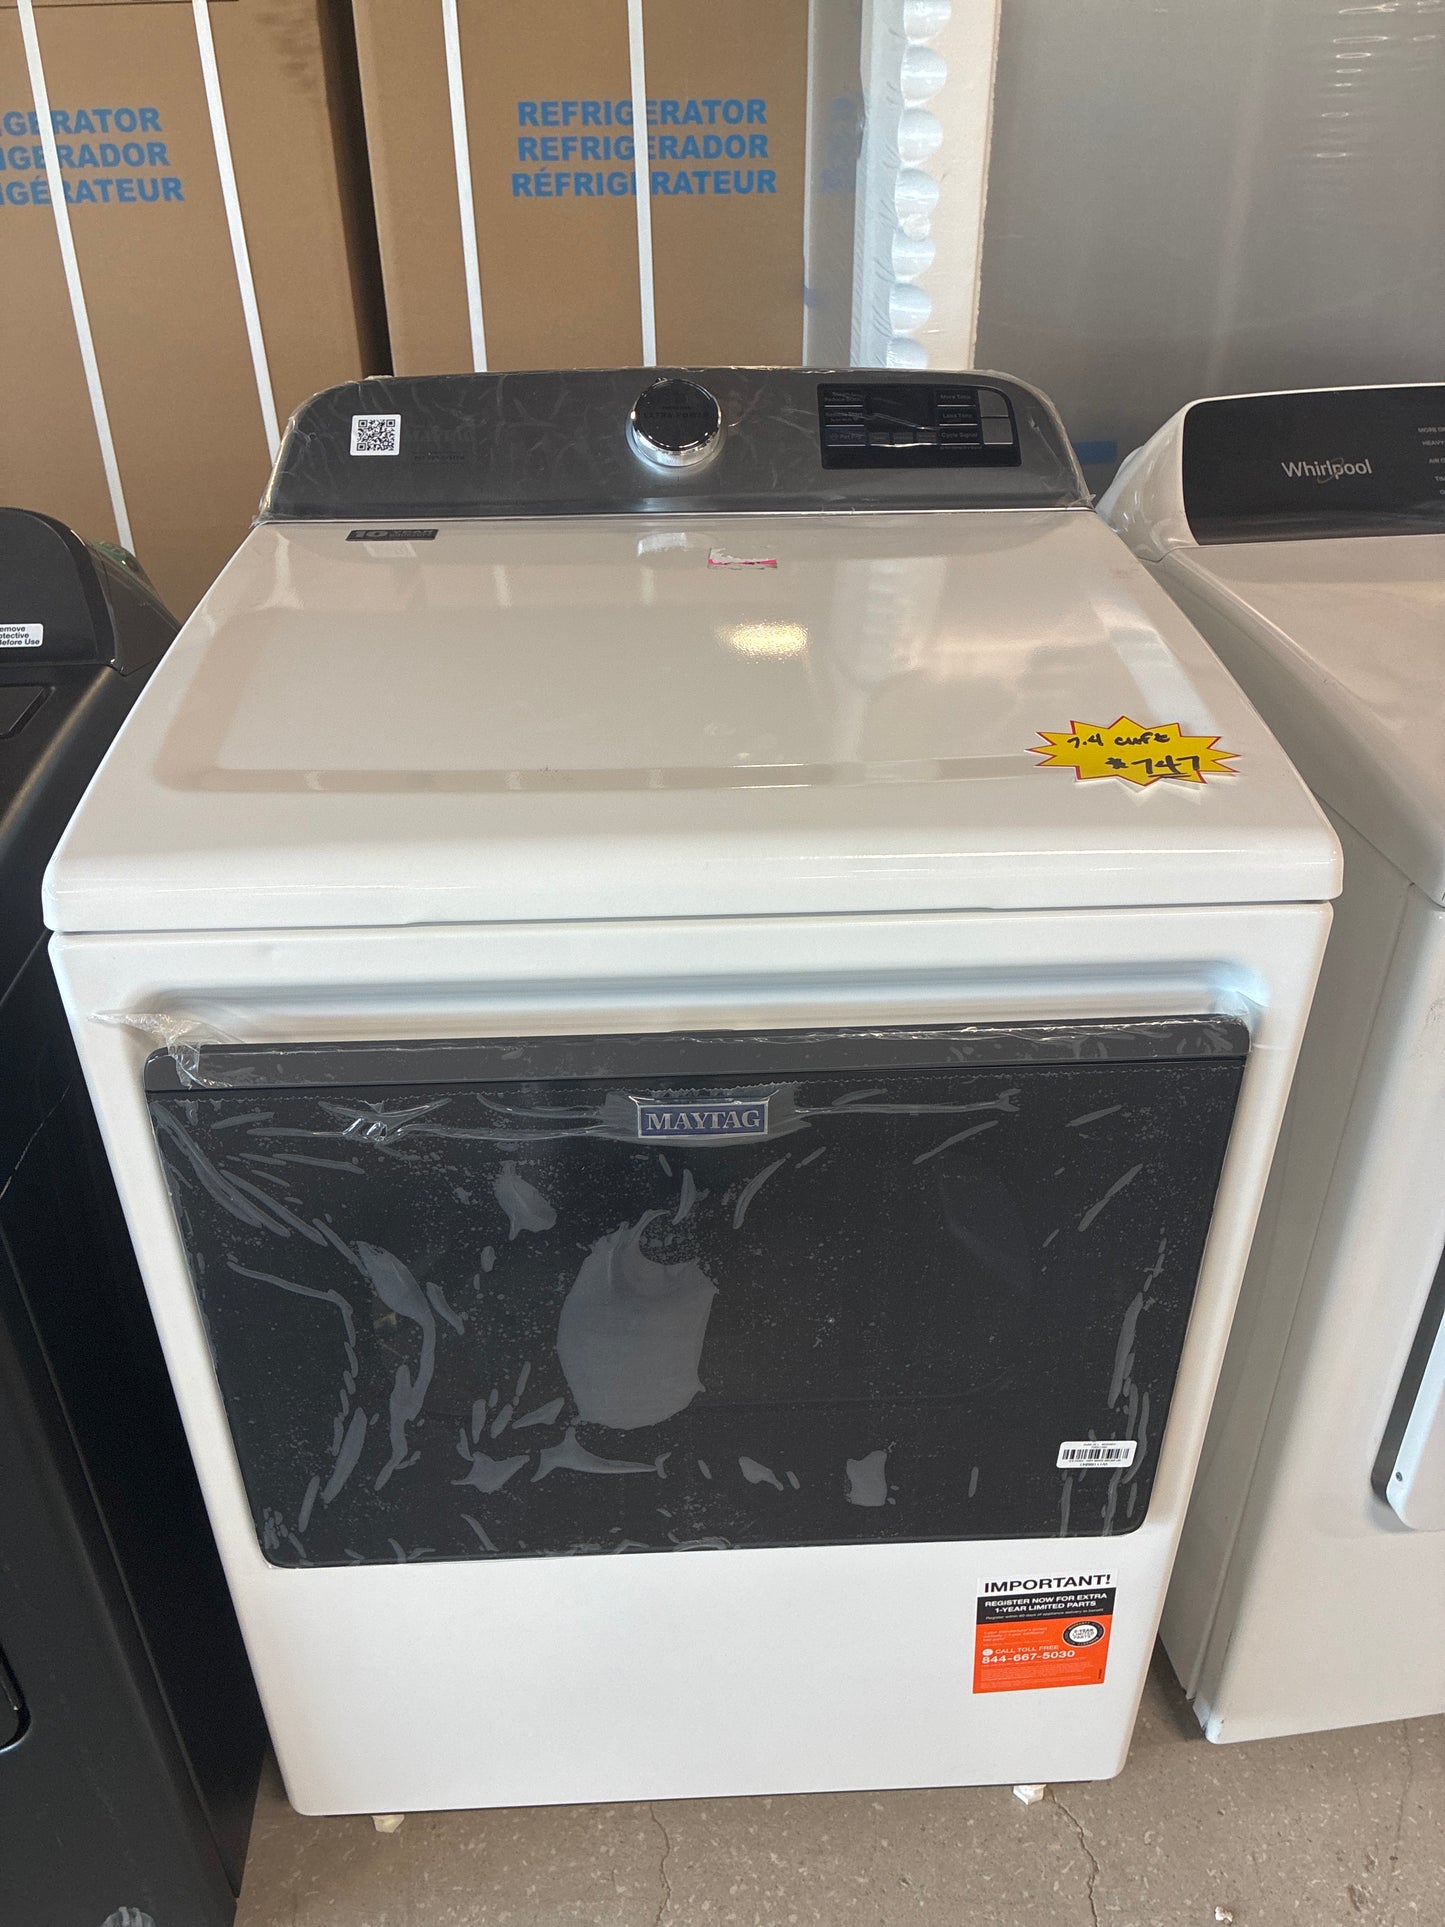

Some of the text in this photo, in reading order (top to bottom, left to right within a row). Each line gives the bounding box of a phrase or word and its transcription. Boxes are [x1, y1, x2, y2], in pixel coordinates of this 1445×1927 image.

[1281, 458, 1372, 480] Whirlpool
[646, 1110, 761, 1131] MAYTAG
[984, 1574, 1111, 1593] IMPORTANT!
[985, 1598, 1030, 1607] REGISTER
[995, 1600, 1097, 1614] 1-YEAR LIMITED PARTS
[982, 1650, 1075, 1664] 844-667-5030
